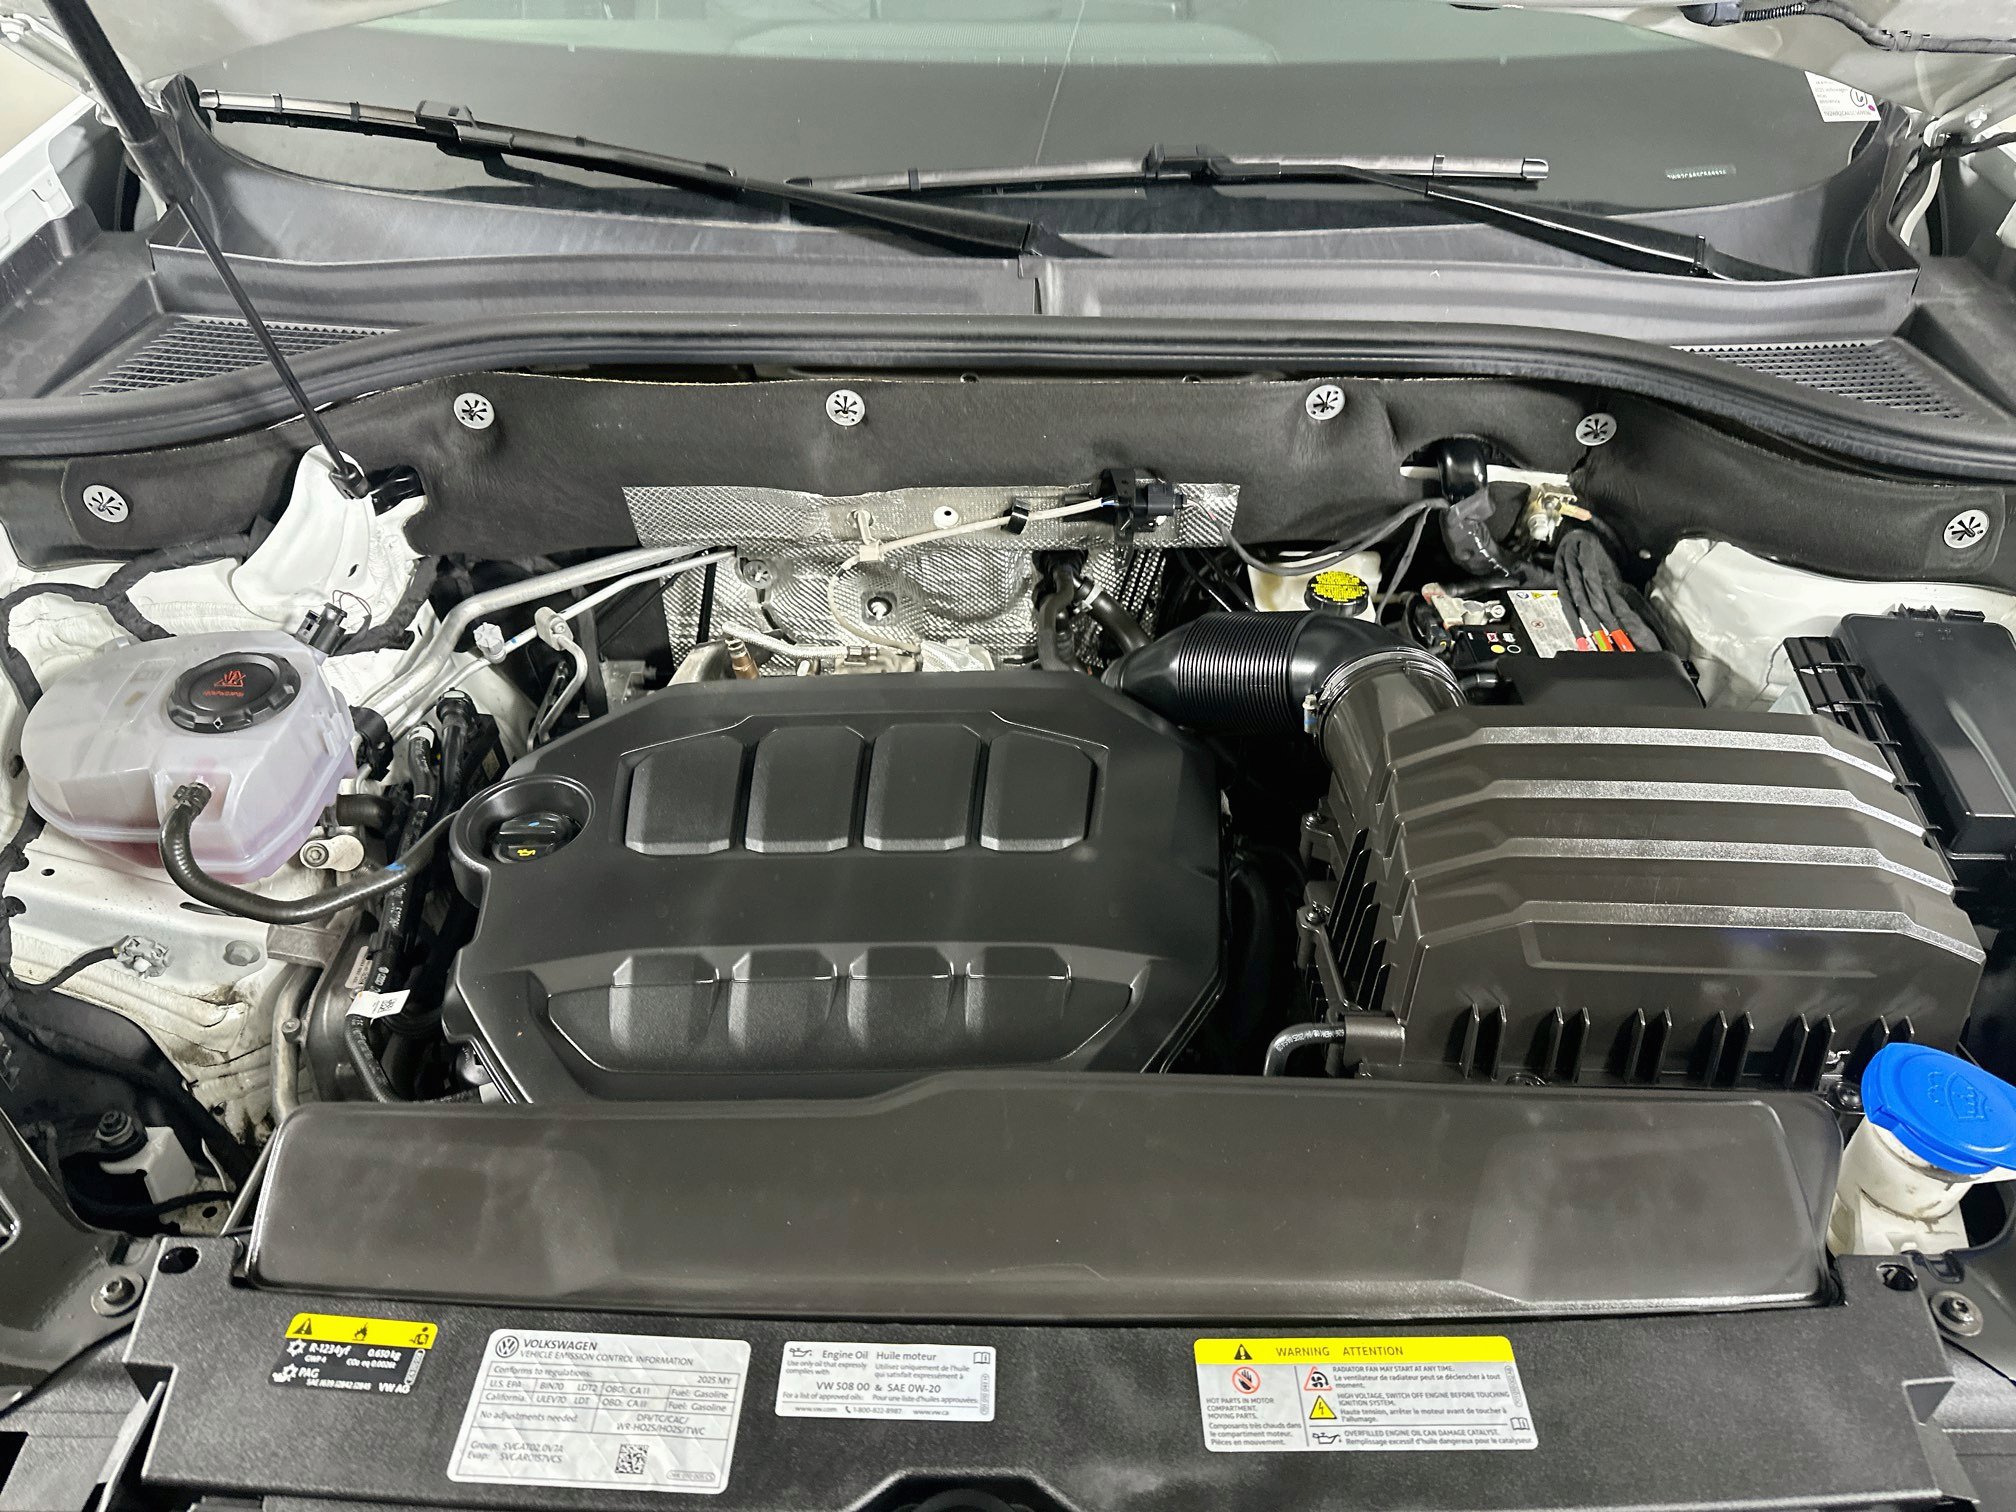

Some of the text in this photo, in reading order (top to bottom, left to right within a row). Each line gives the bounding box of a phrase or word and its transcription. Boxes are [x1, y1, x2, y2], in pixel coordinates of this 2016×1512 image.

[524, 1338, 598, 1350] VOLKSWAGEN
[822, 1350, 868, 1360] Engine Oil
[876, 1352, 936, 1360] Huile moteur
[1275, 1346, 1404, 1356] WARNING ATTENTION
[520, 1350, 694, 1366] VEHICLE EMISSION CONTROL INFORMATION
[494, 1366, 532, 1374] Conforms
[838, 1362, 868, 1370] expressly
[900, 1364, 940, 1372] uniquement
[298, 1367, 320, 1378] PAG
[786, 1368, 814, 1376] complies
[697, 1376, 732, 1385] 2025 MY
[378, 1382, 394, 1393] VW
[394, 1384, 410, 1394] AG
[816, 1382, 834, 1390] VW
[836, 1382, 854, 1390] 508
[856, 1382, 870, 1390] 00
[887, 1384, 906, 1392] SAE
[908, 1384, 942, 1393] 0W-20
[486, 1392, 590, 1405] California ULEV70 LDT
[672, 1388, 729, 1399] Fuel: Gasoline
[818, 1393, 850, 1401] approved
[668, 1401, 726, 1412] Fuel: Gasoline
[480, 1411, 544, 1422] No adjustments
[1218, 1430, 1266, 1438] compartiment
